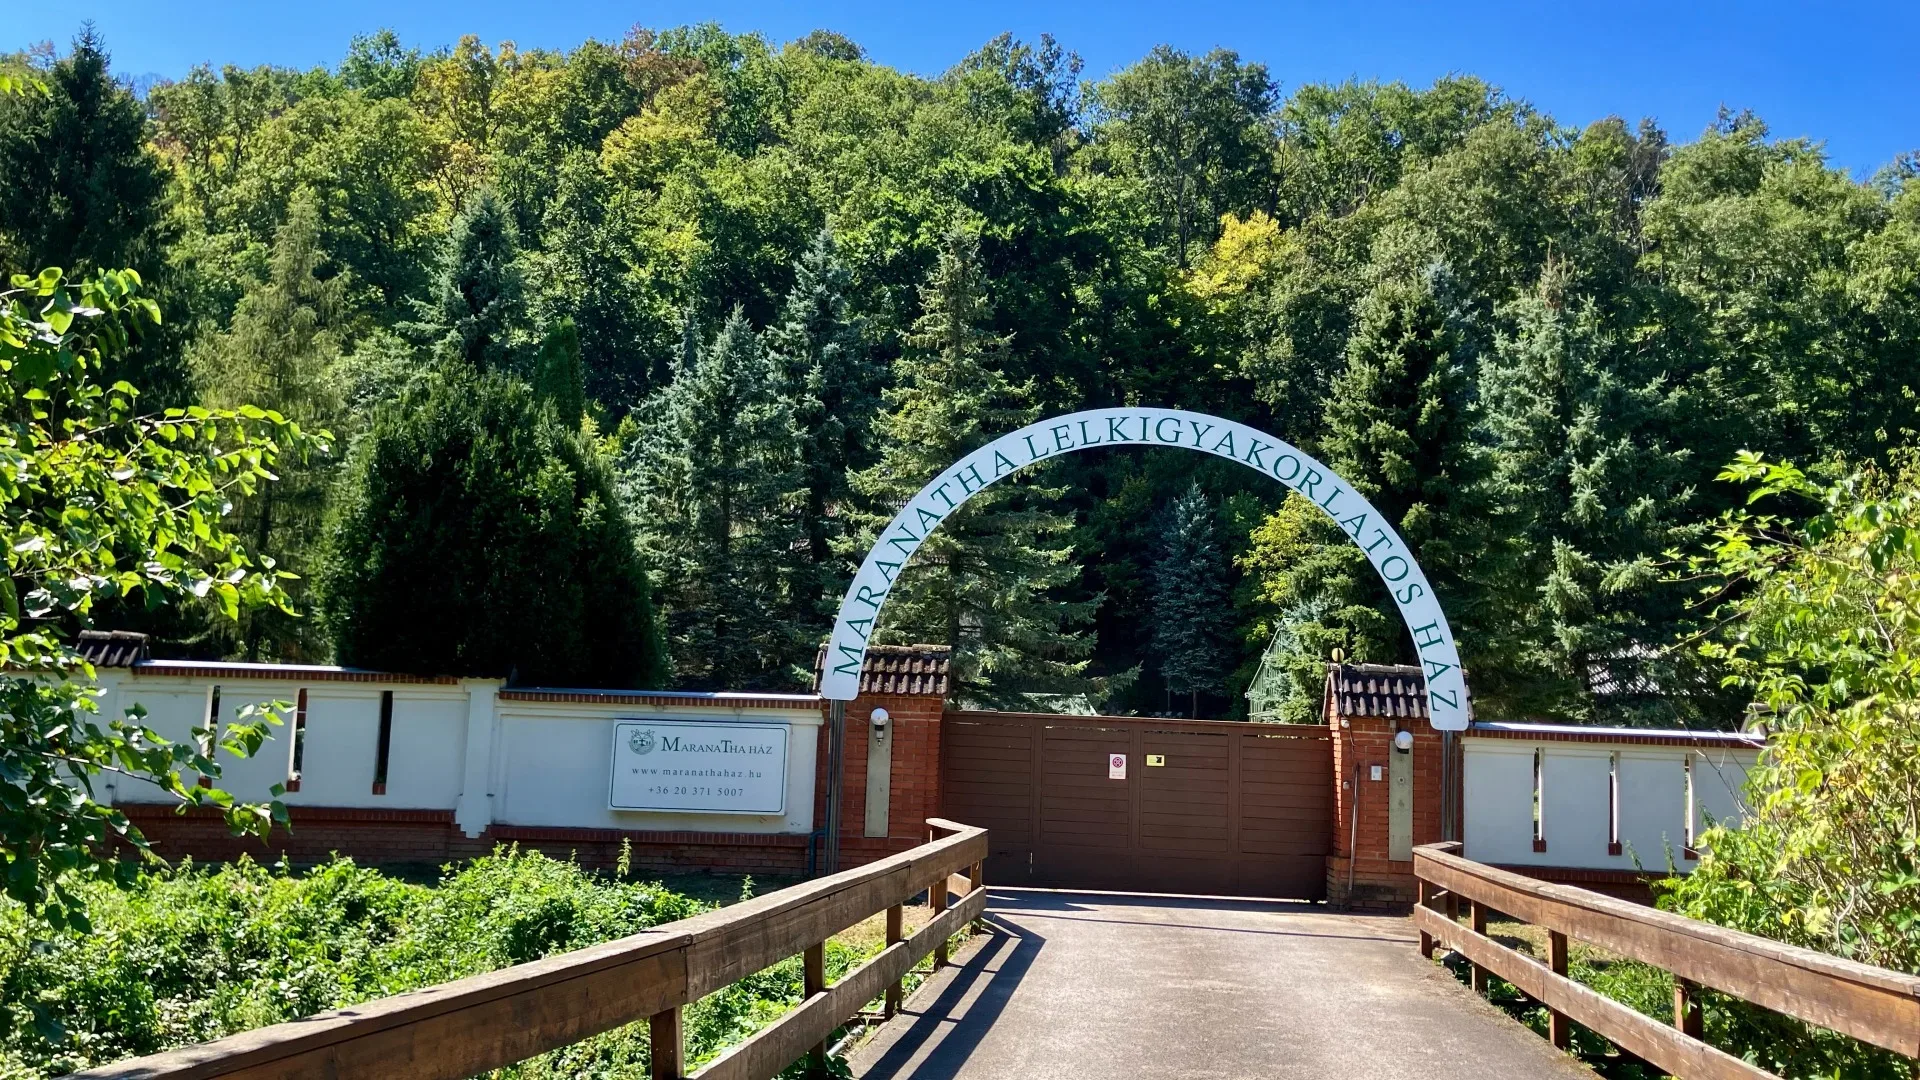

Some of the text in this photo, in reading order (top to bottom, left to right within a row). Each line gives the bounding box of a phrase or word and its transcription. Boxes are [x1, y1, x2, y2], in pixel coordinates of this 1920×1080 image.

[834, 416, 1460, 712] MARANATHA LELKIGYAKORLATOS HÁZ
[649, 785, 744, 797] +36 20 371 5007
